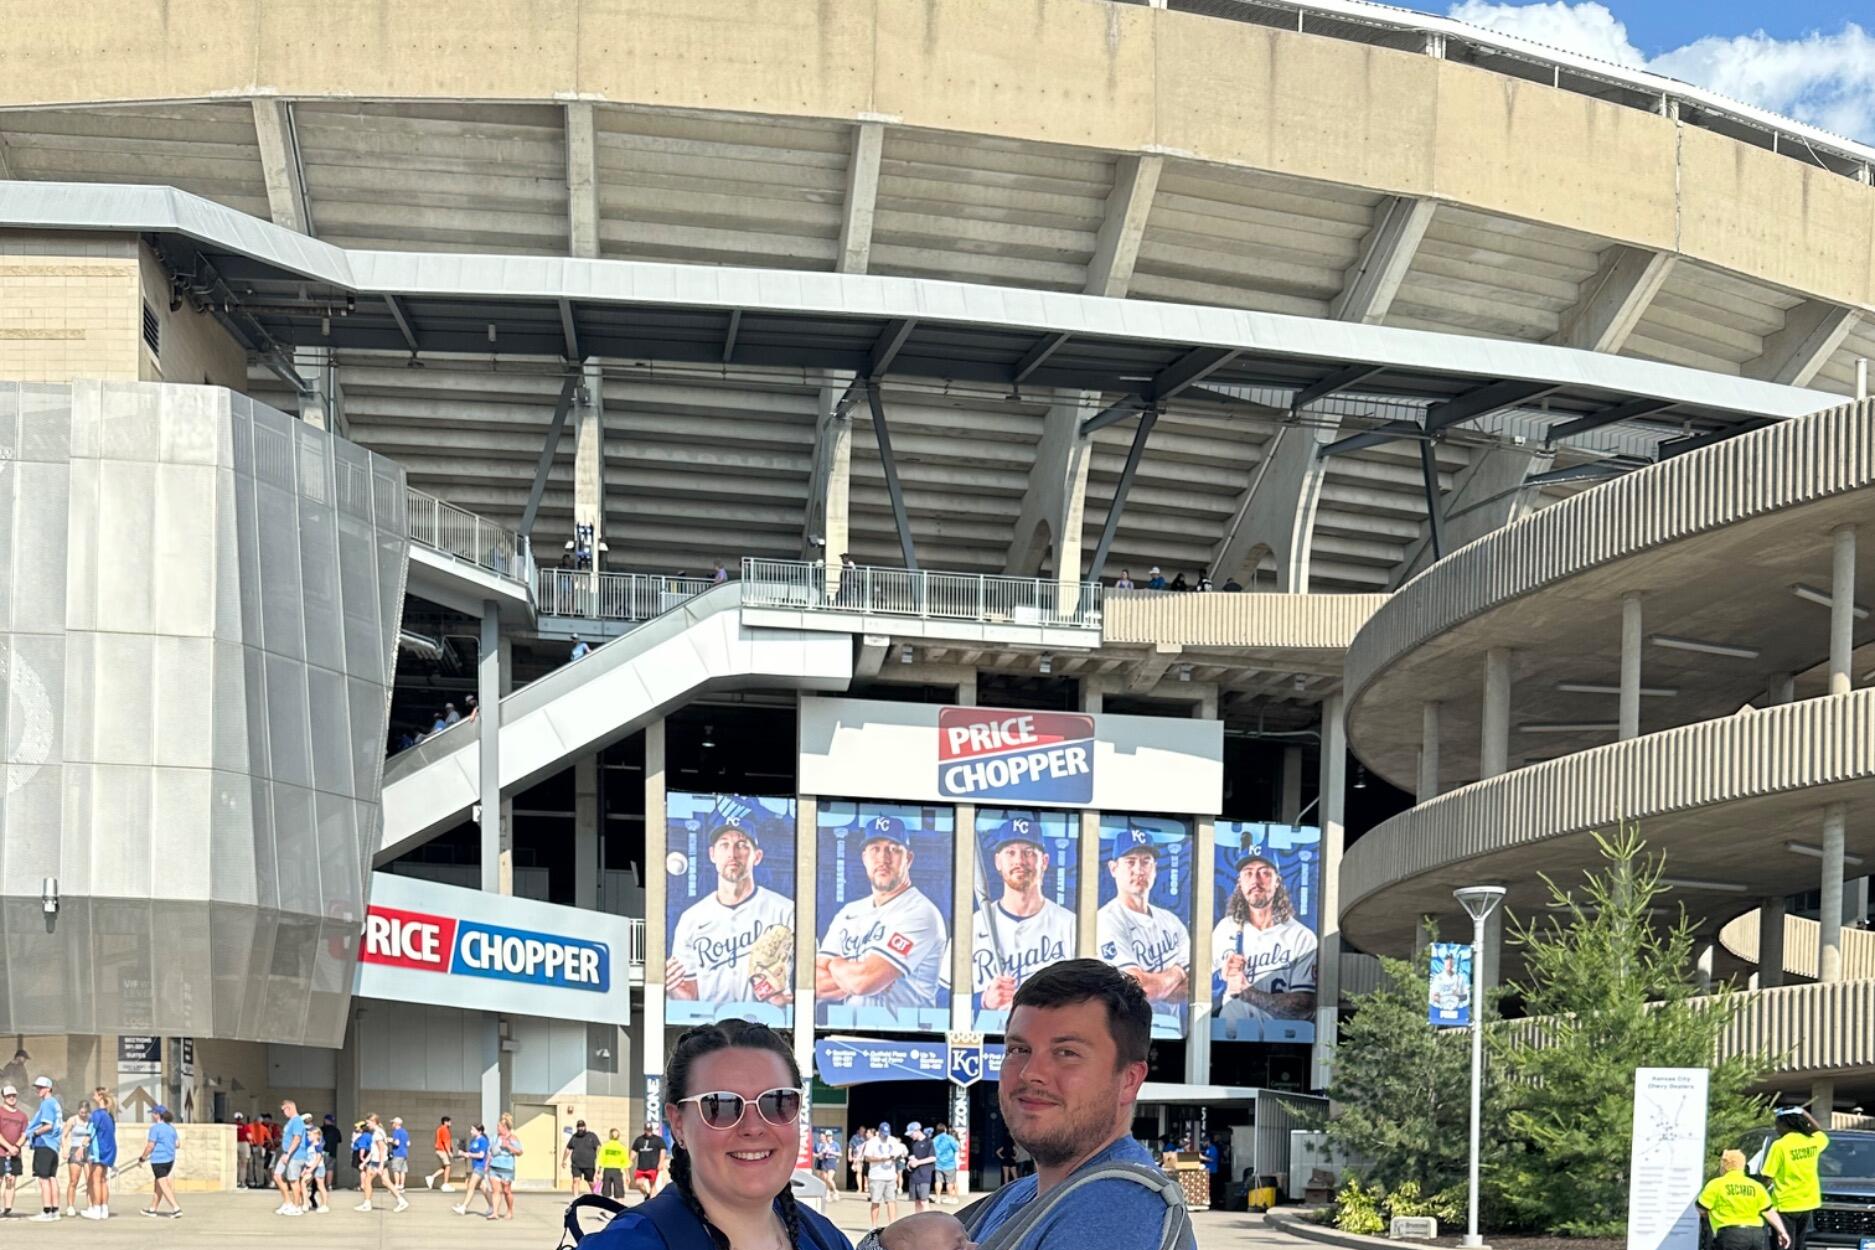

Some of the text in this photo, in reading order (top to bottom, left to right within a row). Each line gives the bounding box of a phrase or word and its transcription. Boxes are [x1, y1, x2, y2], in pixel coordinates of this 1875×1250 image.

[948, 716, 1038, 755] PRICE
[944, 747, 1089, 795] CHOPPER
[874, 815, 891, 832] KC
[1012, 818, 1030, 835] KC
[1131, 829, 1147, 844] KC
[361, 914, 601, 984] RICE CHOPPER
[692, 919, 764, 970] Royal
[951, 1050, 980, 1077] KC
[646, 1078, 660, 1121] ZONE
[955, 1085, 967, 1126] ZONE
